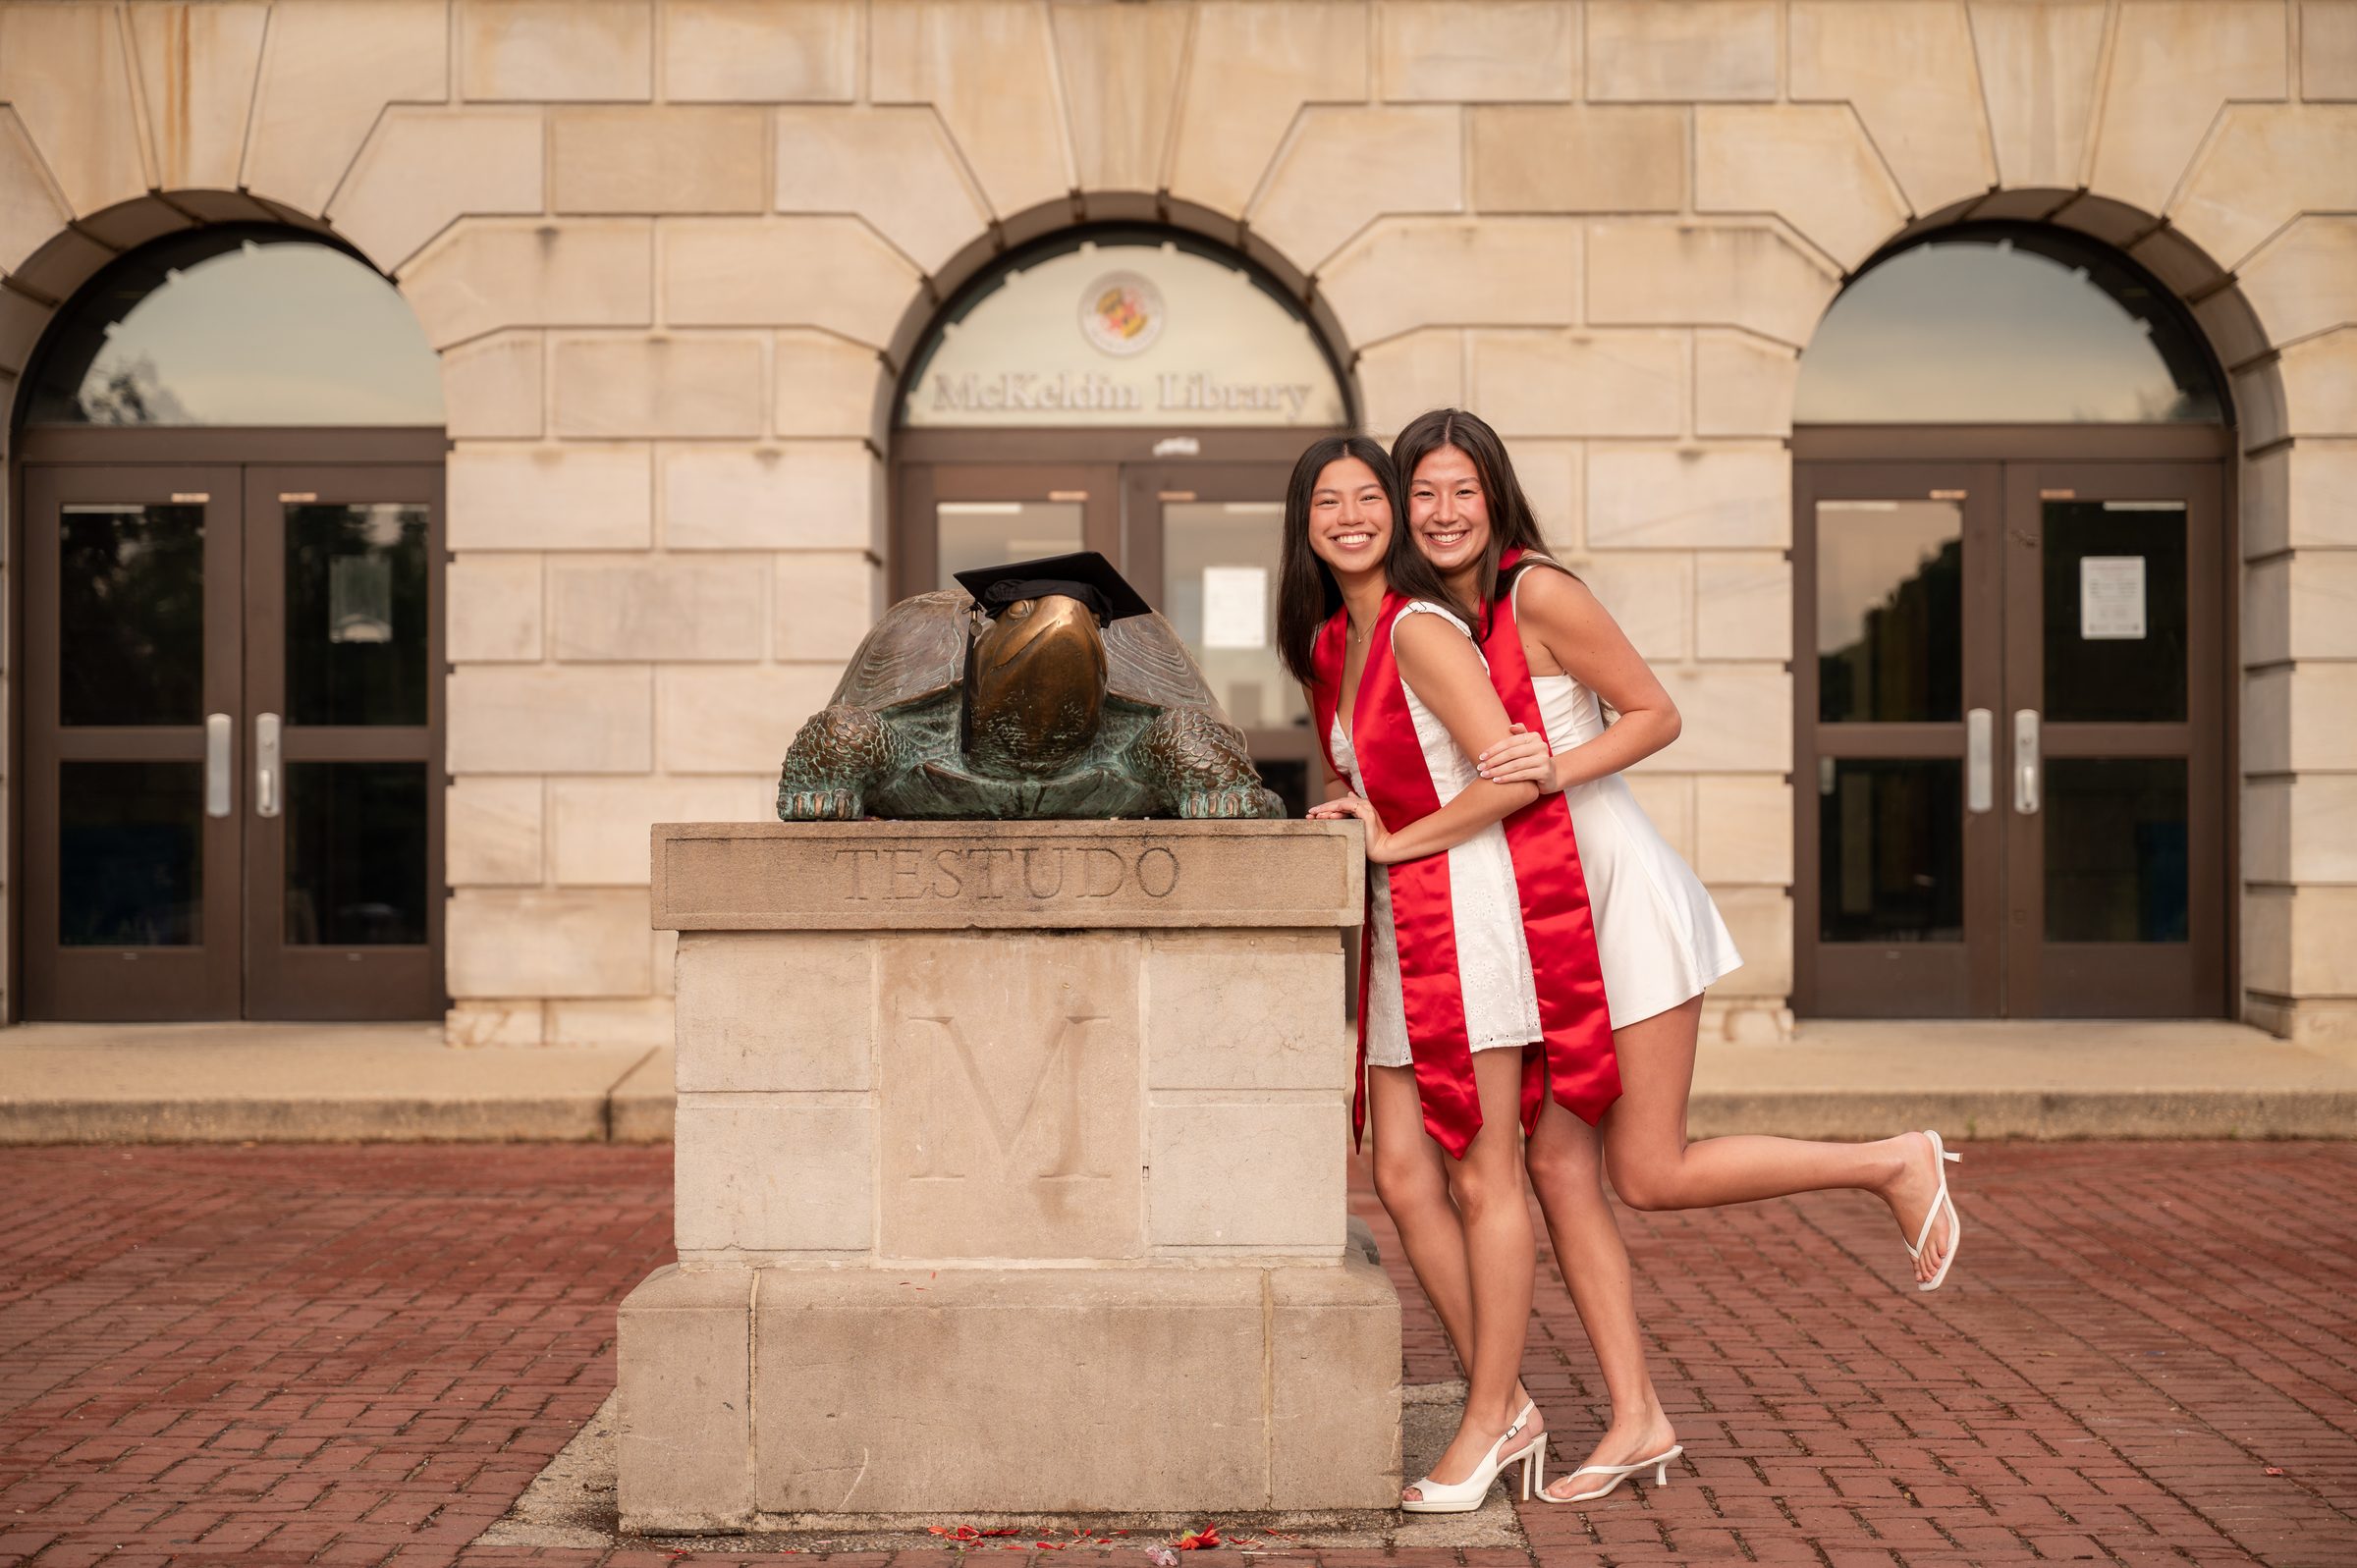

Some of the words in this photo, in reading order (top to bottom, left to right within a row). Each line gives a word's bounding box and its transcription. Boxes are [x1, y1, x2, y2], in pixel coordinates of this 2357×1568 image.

[930, 370, 1142, 412] McKeldin
[1155, 370, 1314, 421] Library
[834, 846, 1179, 901] TESTUDO
[907, 1014, 1113, 1179] M
